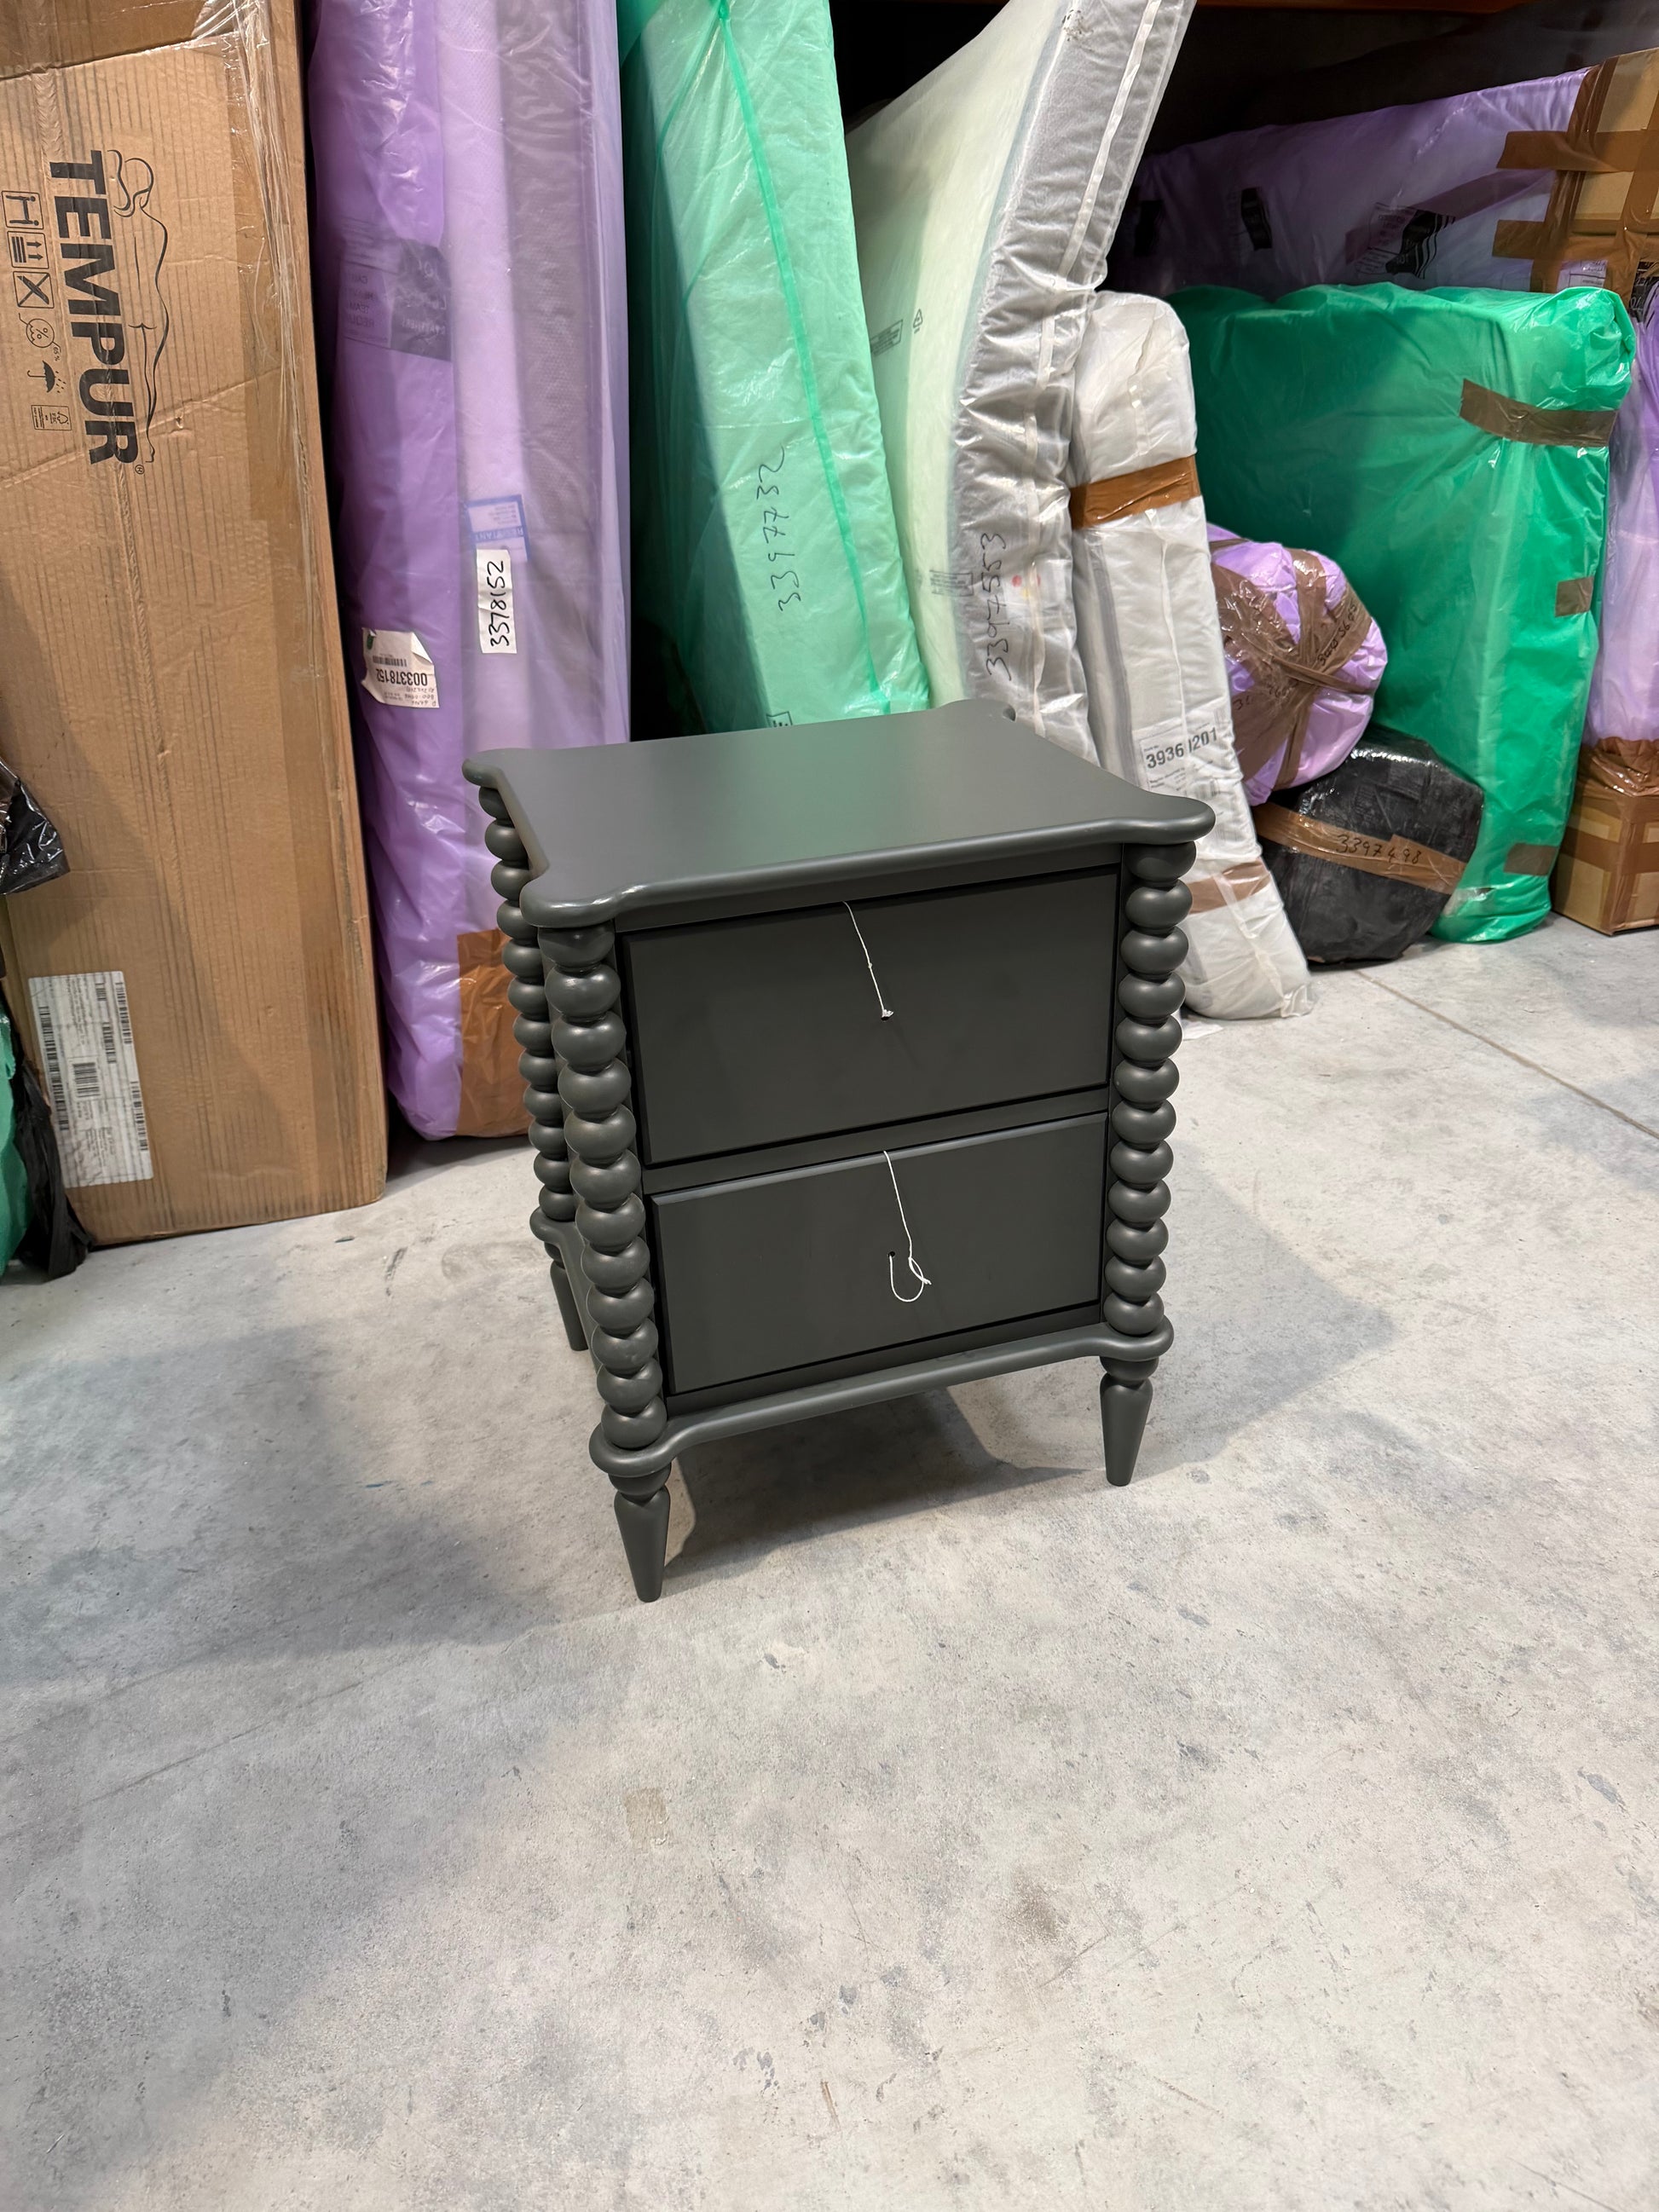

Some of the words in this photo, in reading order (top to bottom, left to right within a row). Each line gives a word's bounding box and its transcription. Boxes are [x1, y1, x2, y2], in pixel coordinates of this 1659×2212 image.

[49, 149, 139, 465] TEMPUR
[756, 443, 801, 611] 3397732
[487, 560, 510, 646] 3378152
[980, 533, 1012, 681] 3397553
[376, 669, 428, 686] 003378152
